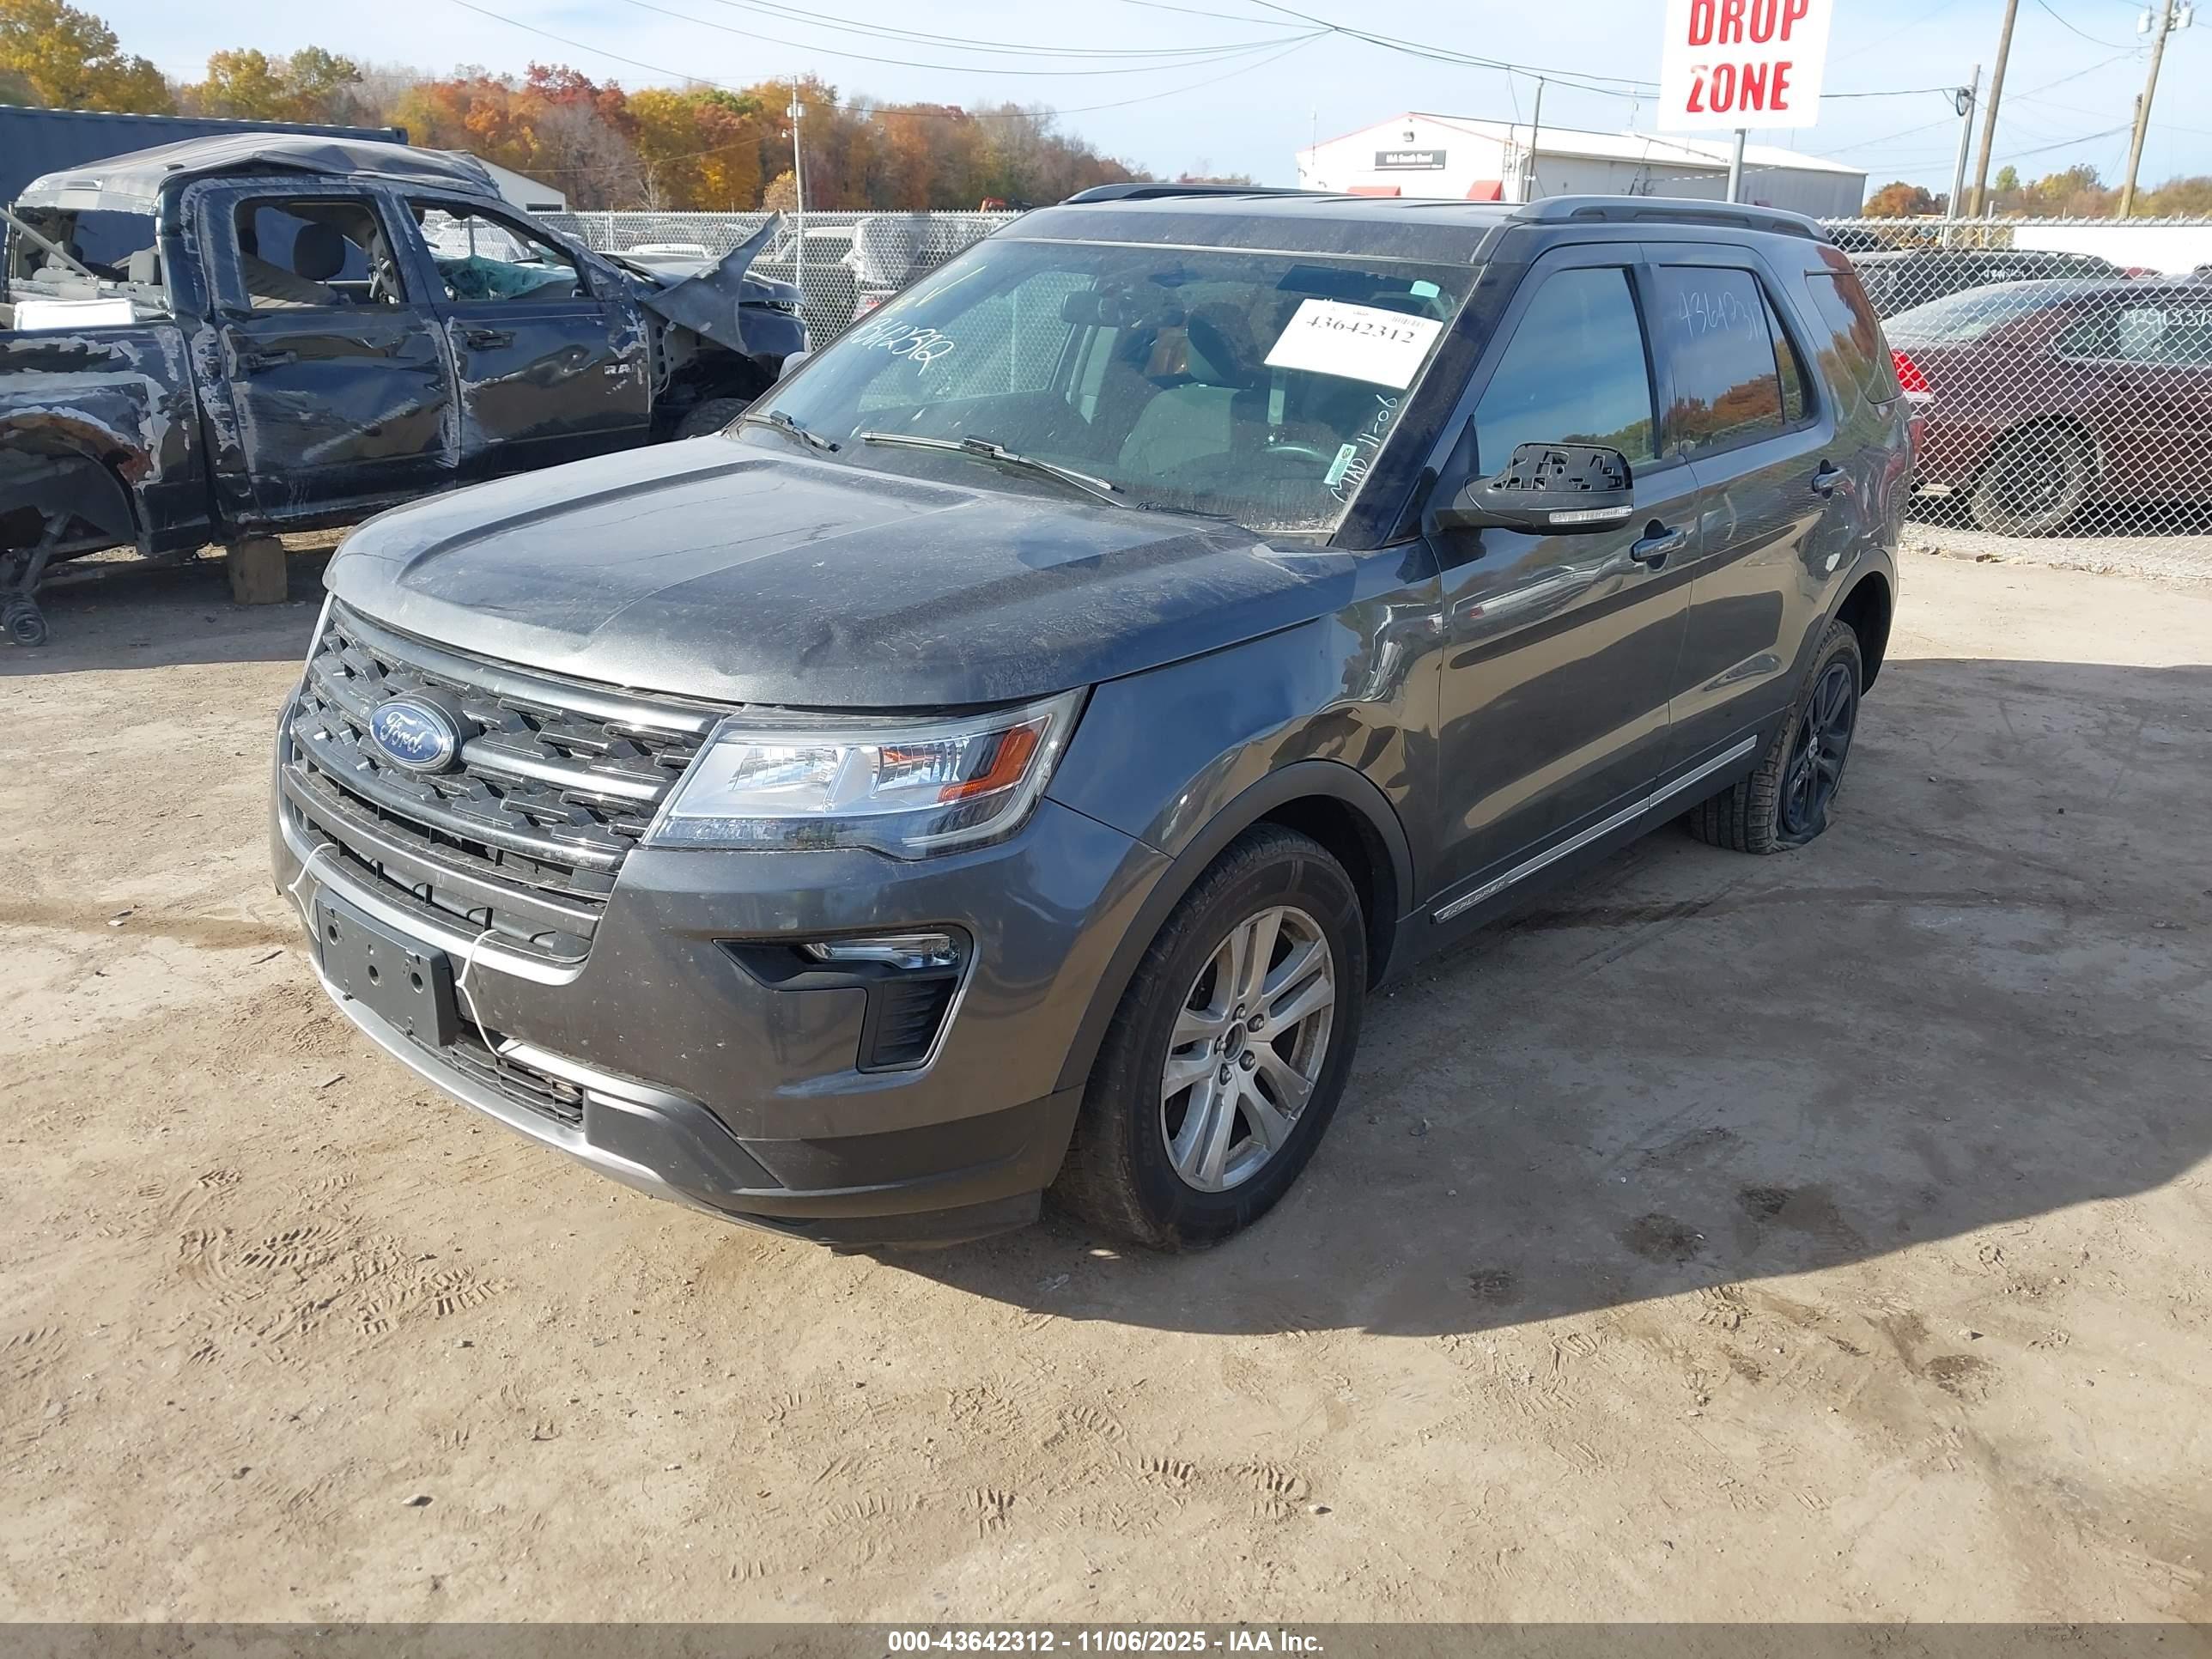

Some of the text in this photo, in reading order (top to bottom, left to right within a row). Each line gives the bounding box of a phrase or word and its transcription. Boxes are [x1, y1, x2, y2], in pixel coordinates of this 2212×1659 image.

[1688, 0, 1809, 46] DROP
[1686, 61, 1793, 112] ZONE
[1306, 314, 1416, 343] 43642312
[380, 711, 427, 754] Ford
